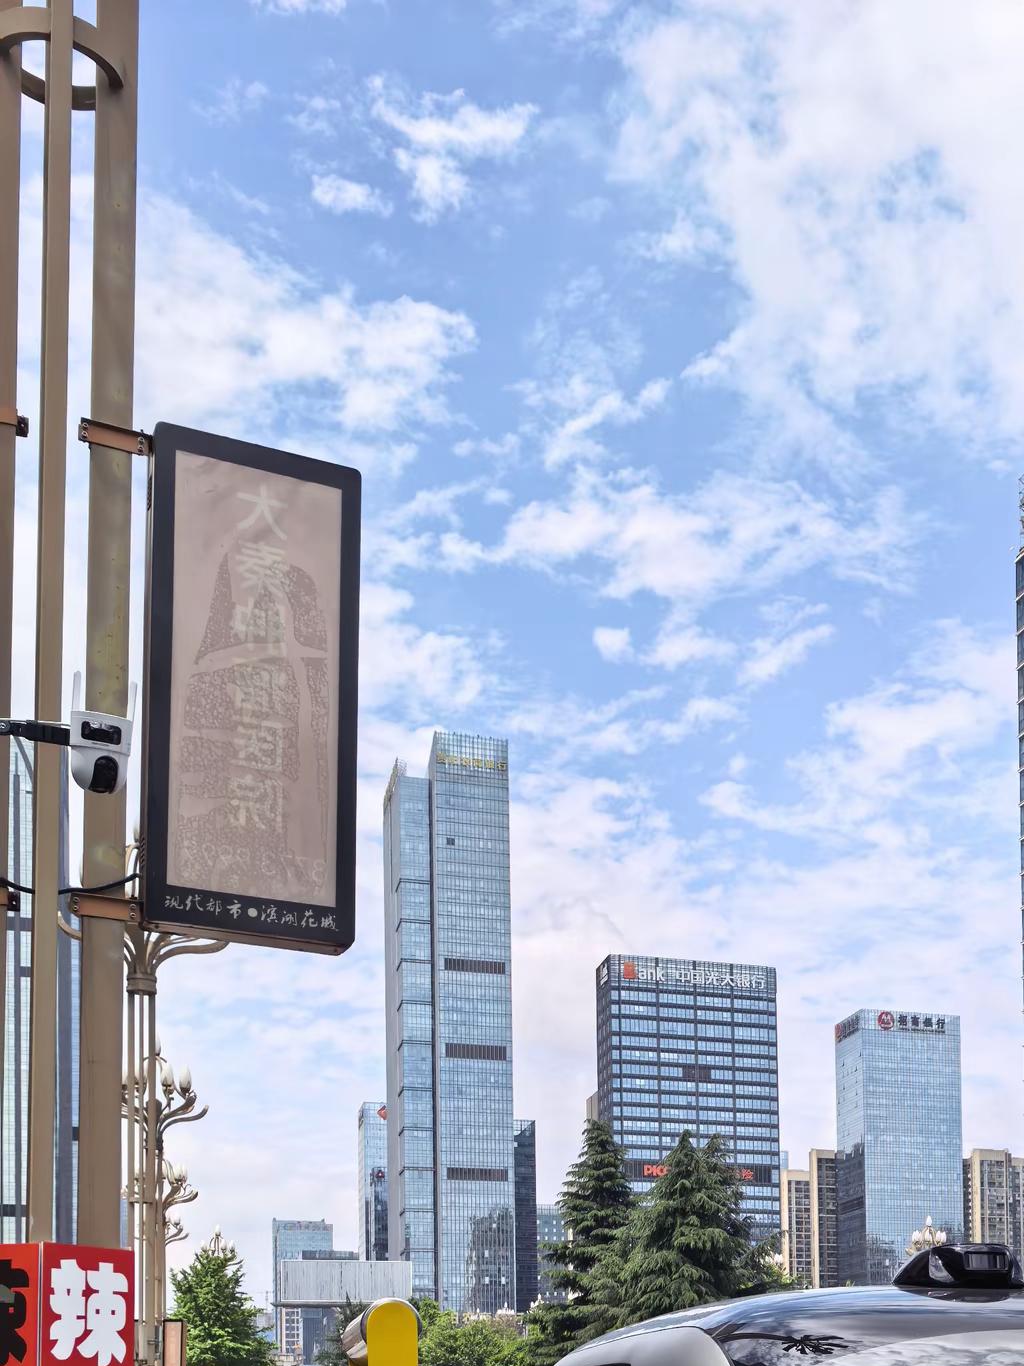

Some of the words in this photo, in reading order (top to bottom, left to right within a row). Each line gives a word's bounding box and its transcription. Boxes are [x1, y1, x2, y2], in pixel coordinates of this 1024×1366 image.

[676, 968, 766, 990] 中国光大银行
[898, 1014, 946, 1030] 招商银行
[643, 1163, 673, 1178] PIC
